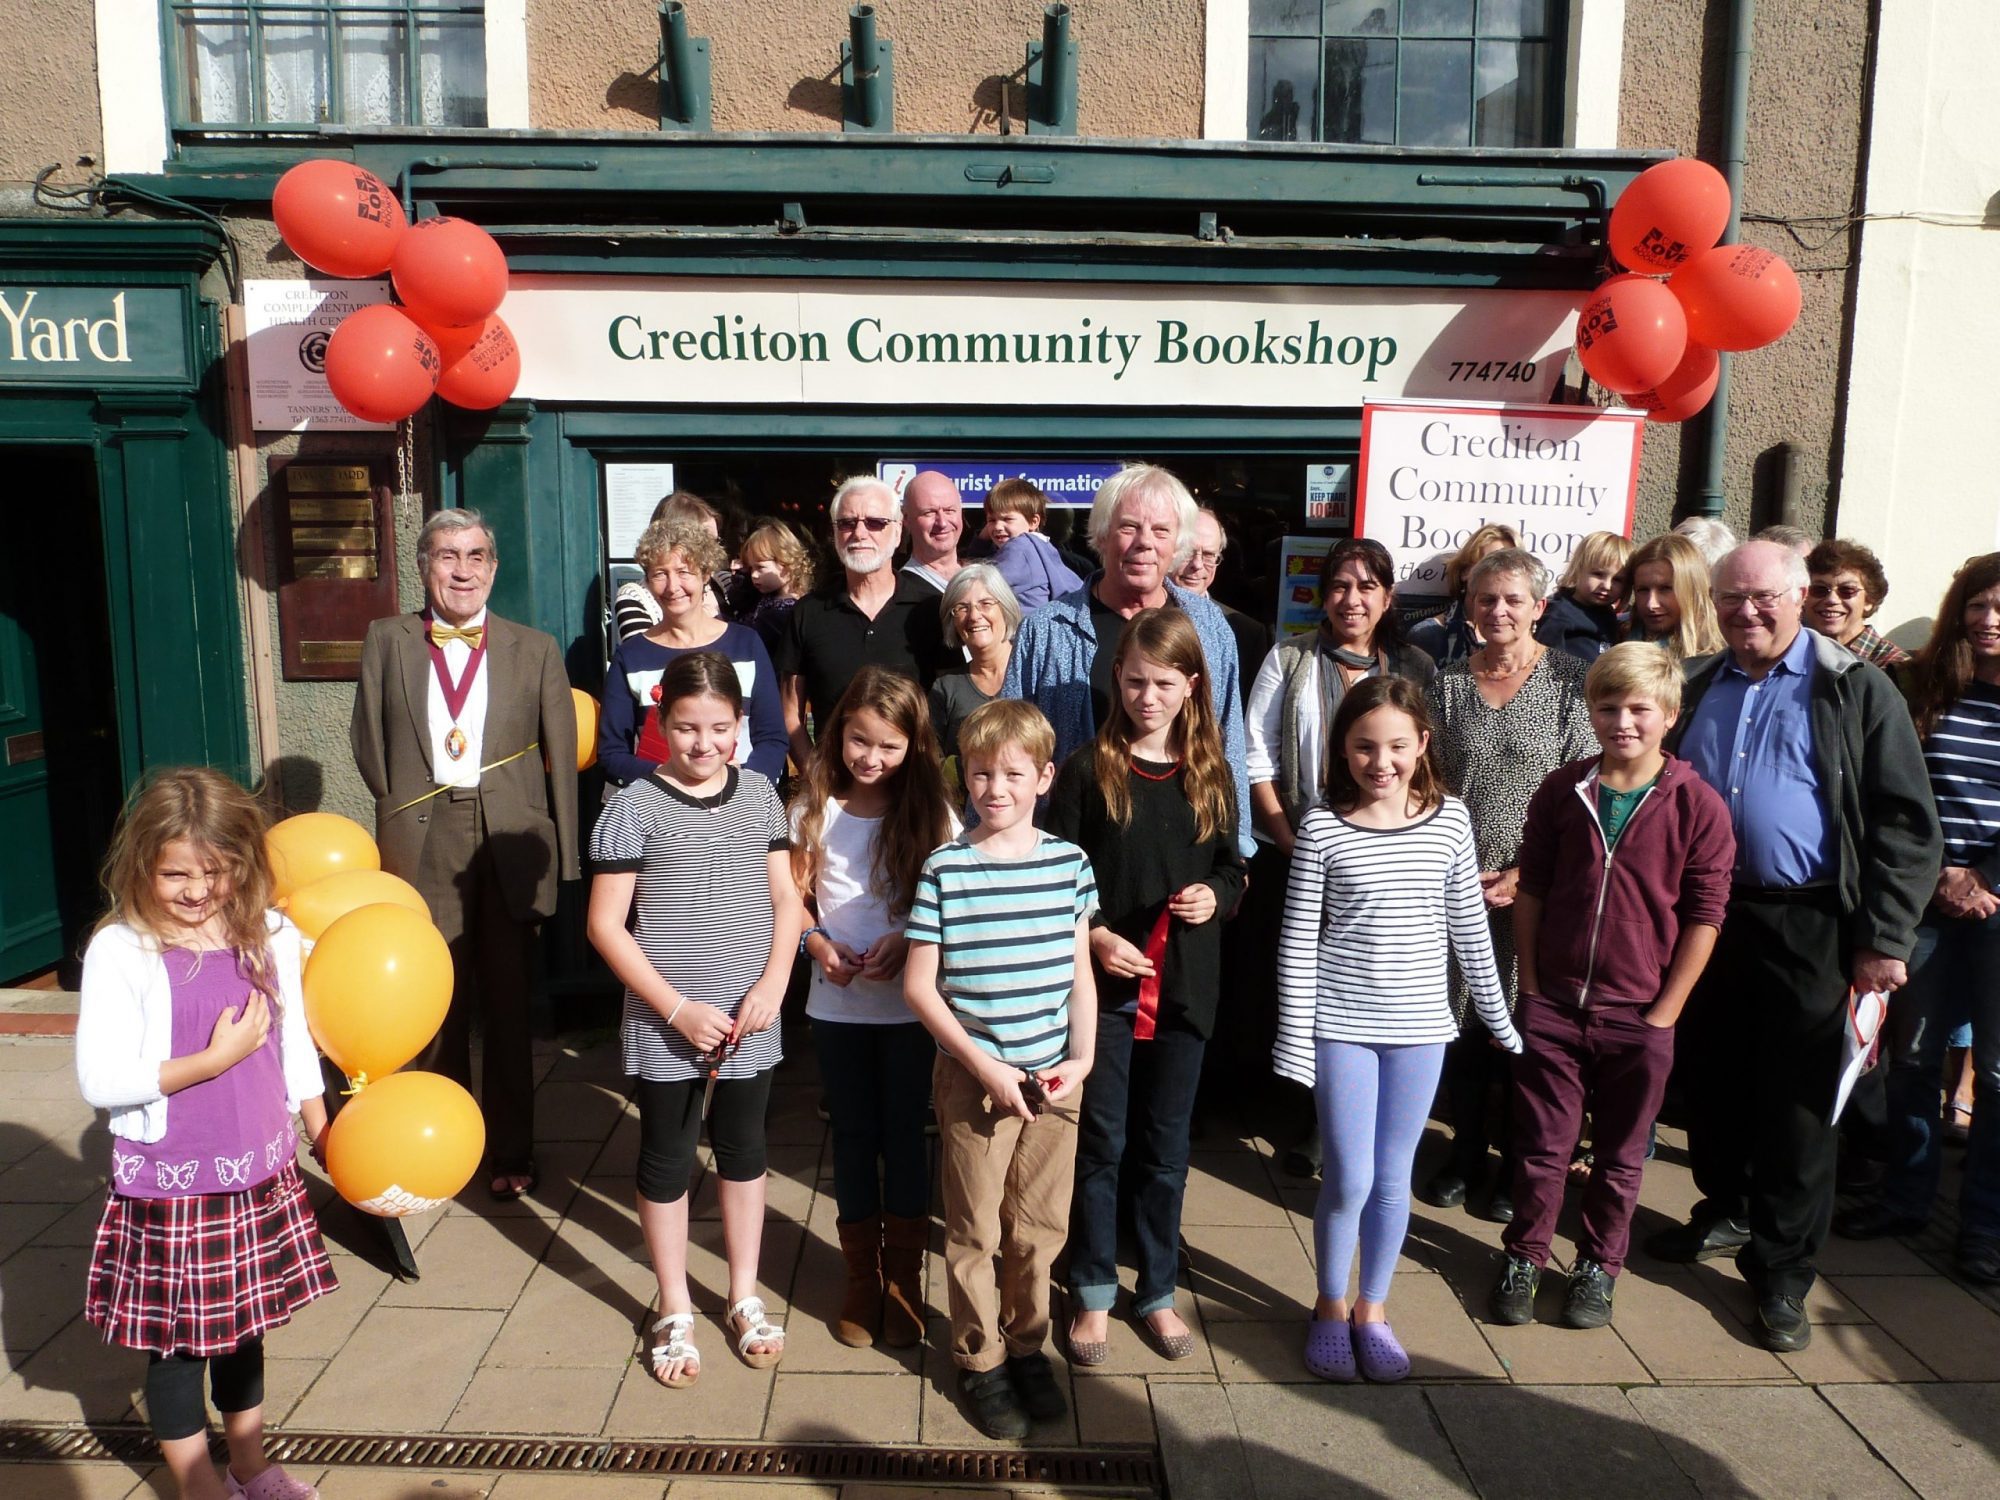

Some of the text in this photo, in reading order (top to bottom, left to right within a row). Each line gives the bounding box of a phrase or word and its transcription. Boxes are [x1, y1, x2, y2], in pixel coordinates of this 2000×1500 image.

[361, 171, 382, 223] LOVE
[1640, 234, 1690, 263] LOVE
[285, 290, 349, 300] CREDITON
[263, 303, 371, 313] COMPLEMENTAR
[0, 291, 133, 362] Yard
[269, 316, 344, 326] HEALTH CEN
[608, 314, 1397, 382] Crediton Community Bookshop
[1448, 361, 1536, 382] 774740
[333, 405, 350, 414] YA
[1420, 421, 1582, 462] Crediton
[950, 473, 993, 492] urist
[1389, 466, 1608, 516] Community
[1310, 492, 1347, 502] KEEP TRADE
[1310, 502, 1347, 518] LOCAL
[1400, 515, 1585, 563] Boohop
[1399, 561, 1439, 581] the
